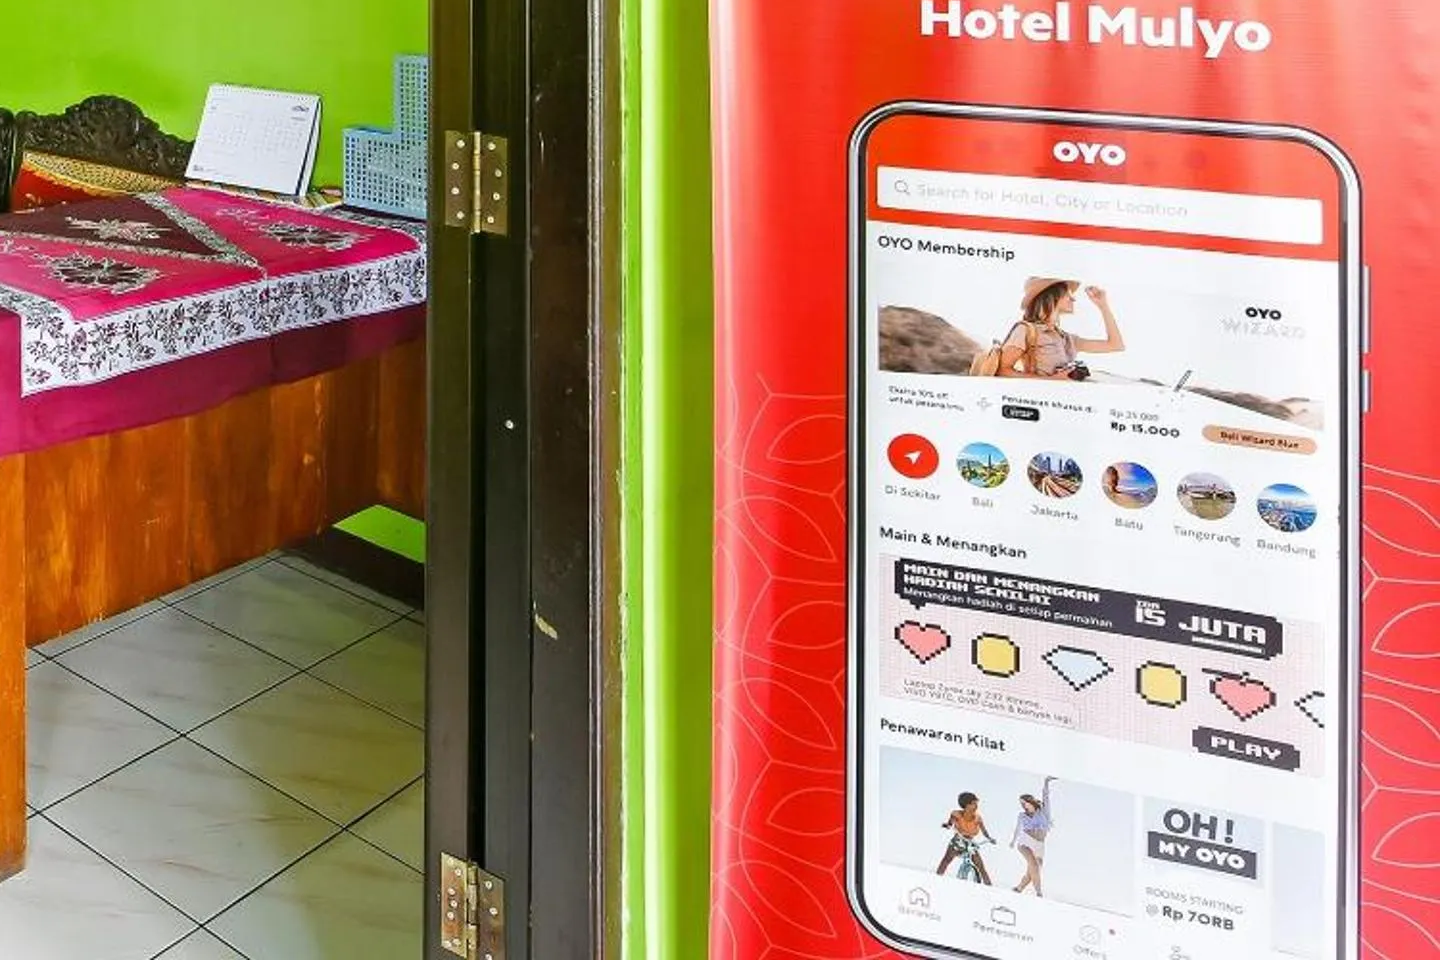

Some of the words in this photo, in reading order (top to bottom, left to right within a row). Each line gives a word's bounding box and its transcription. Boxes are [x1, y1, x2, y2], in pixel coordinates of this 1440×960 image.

[1088, 4, 1273, 60] Mulyo
[1052, 140, 1127, 166] OYO
[917, 183, 967, 201] Search
[974, 186, 995, 202] for
[1055, 194, 1089, 212] City
[1116, 199, 1188, 218] Location
[877, 234, 913, 251] OYO
[918, 238, 1016, 262] Membership
[1245, 306, 1282, 321] OYO
[1111, 421, 1126, 433] Rp
[1132, 423, 1180, 438] 15.000
[972, 496, 994, 508] Bali
[1030, 504, 1079, 521] Jakarta
[879, 526, 917, 544] Main
[921, 532, 932, 546] &
[937, 534, 1028, 560] Menangkan
[1173, 525, 1241, 548] Tangerang
[1256, 538, 1317, 559] Bandung
[904, 563, 949, 578] MAIN
[953, 570, 988, 584] DAN
[993, 576, 1100, 603] MENANGKAN
[904, 574, 969, 592] HADIAH
[1178, 615, 1266, 644] JUTA
[880, 717, 963, 744] Penawaran
[967, 733, 1006, 752] Kilat
[1210, 735, 1282, 761] PLAY
[1159, 840, 1191, 858] MY
[1195, 847, 1246, 870] OYO
[1162, 905, 1184, 922] Rp
[1187, 909, 1235, 930] 70RB
